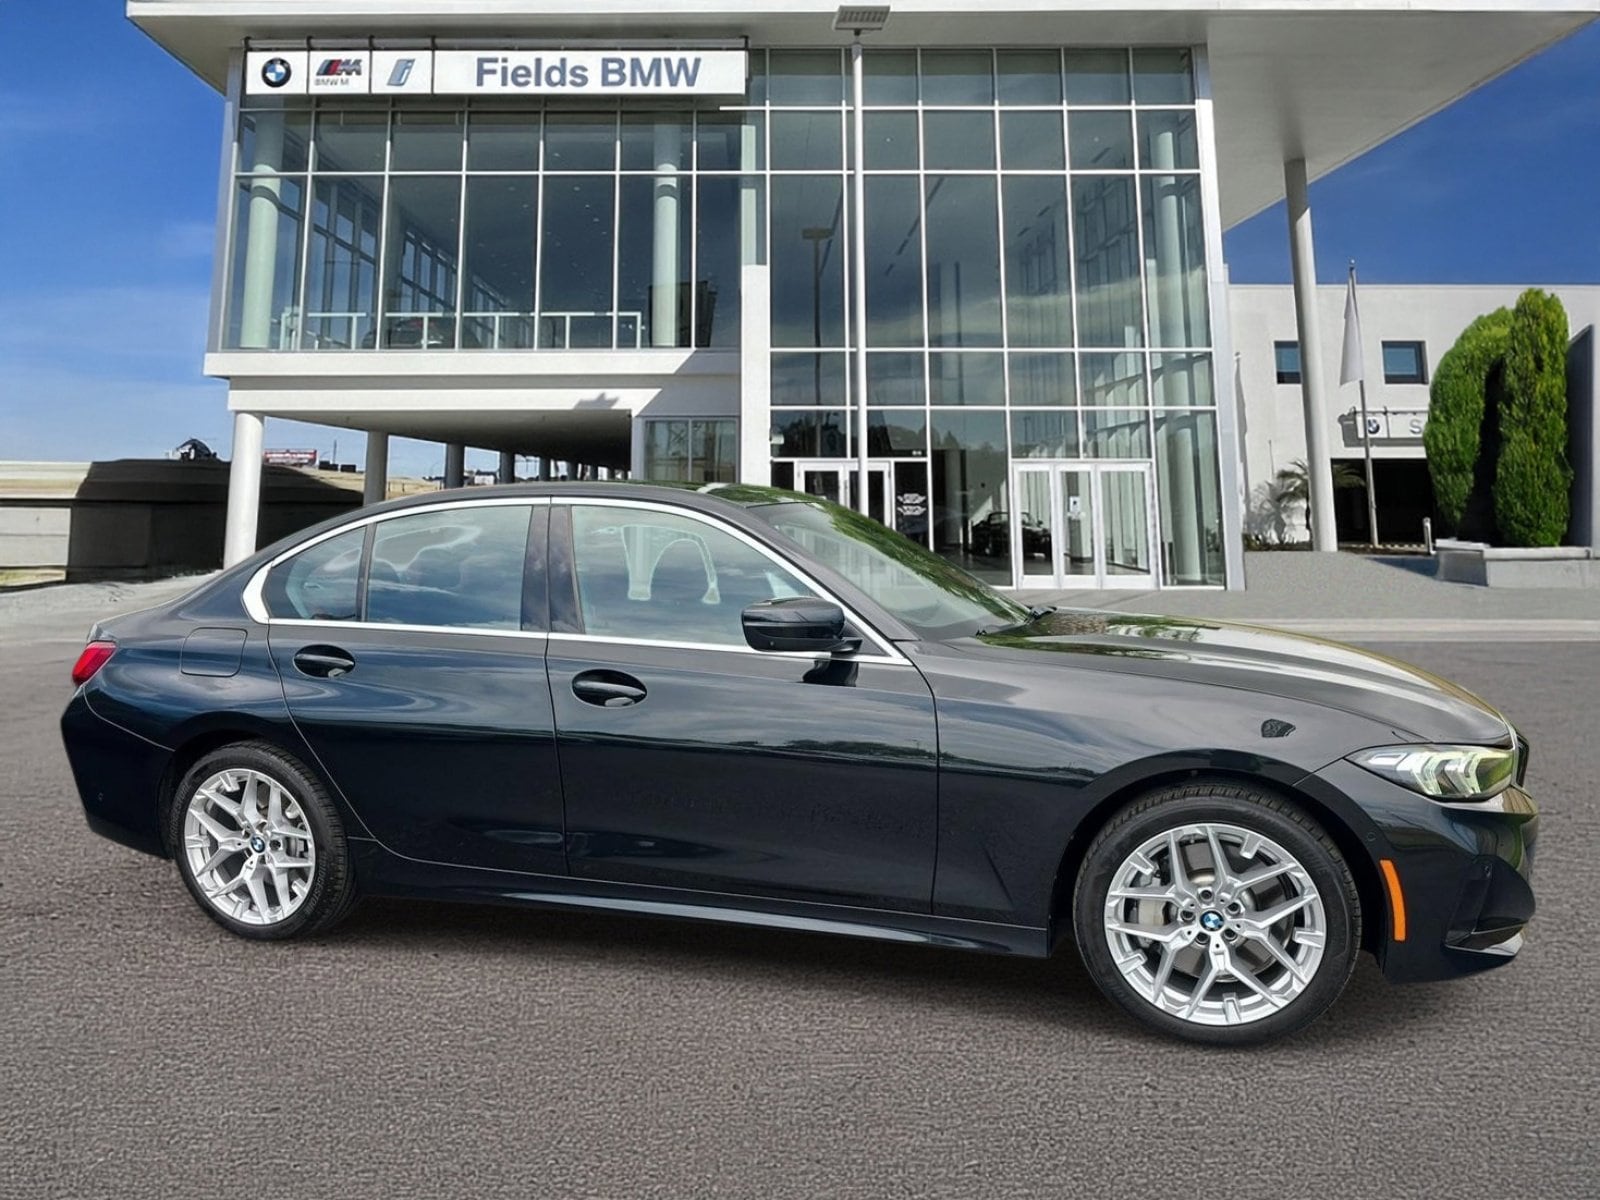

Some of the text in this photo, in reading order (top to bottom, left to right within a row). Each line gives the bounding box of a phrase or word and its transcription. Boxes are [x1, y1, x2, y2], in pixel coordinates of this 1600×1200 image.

[476, 57, 701, 87] Fields BMW
[1409, 419, 1423, 434] S
